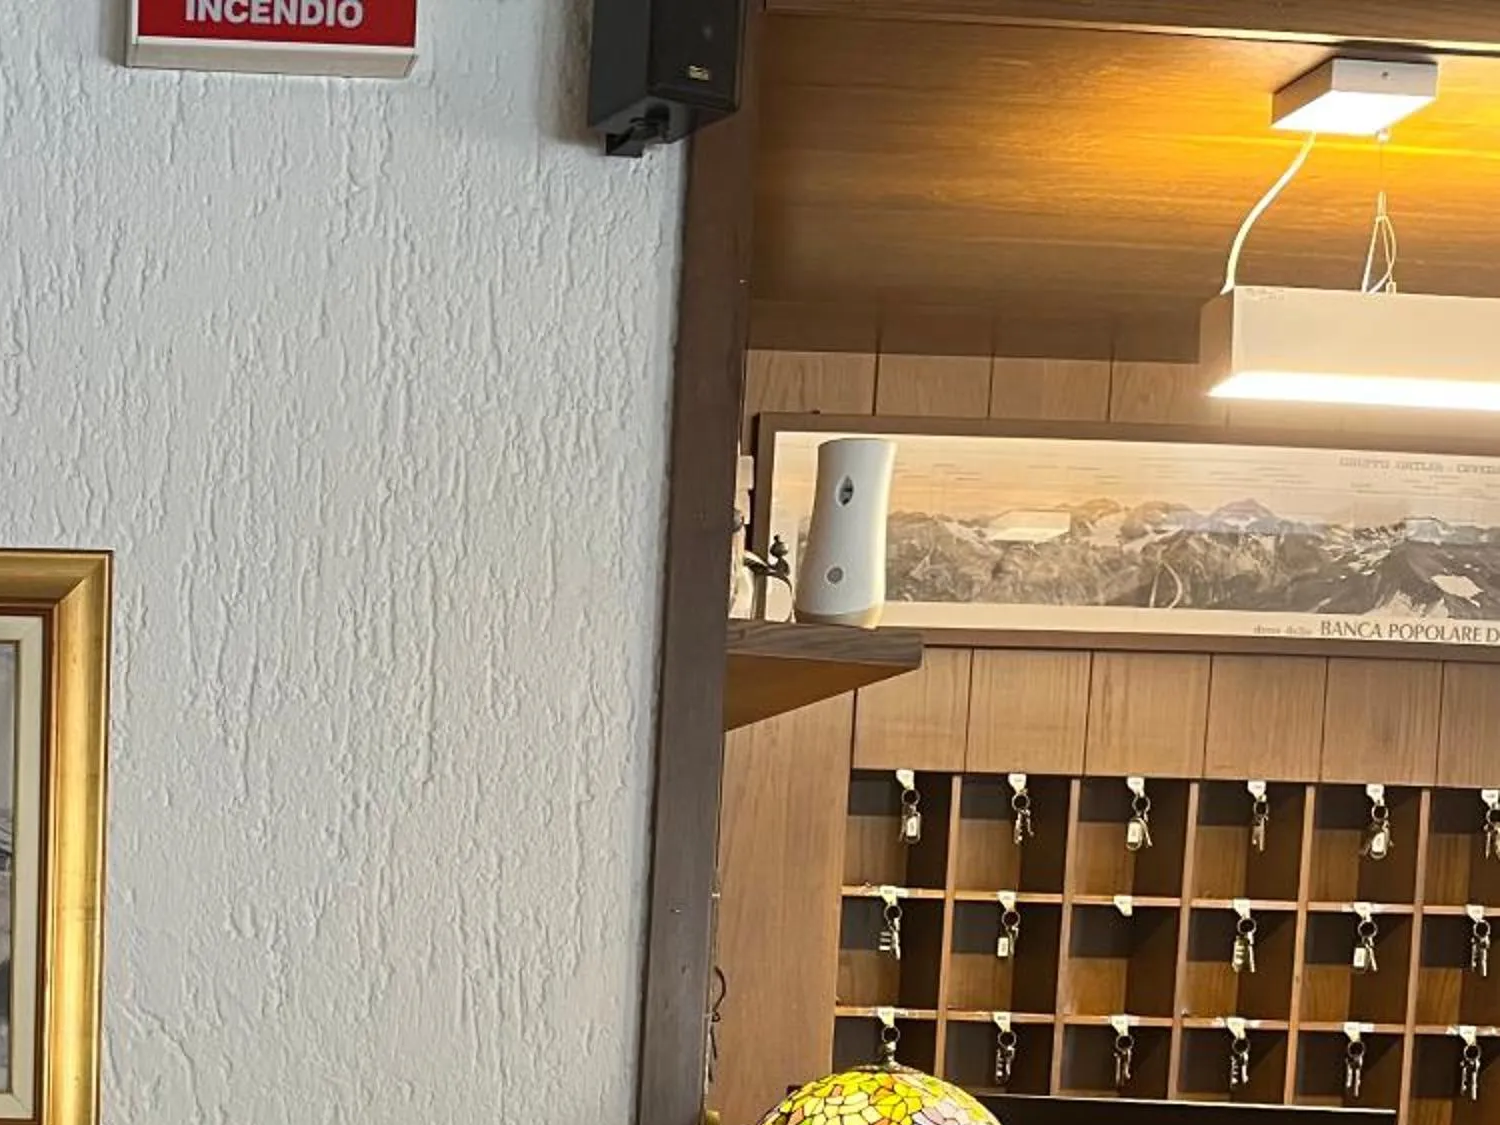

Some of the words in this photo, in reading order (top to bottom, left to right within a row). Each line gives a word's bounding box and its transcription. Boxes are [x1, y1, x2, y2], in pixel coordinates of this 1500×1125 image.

[185, 0, 363, 28] INCENDIO
[1320, 620, 1382, 638] BANCA
[1388, 623, 1482, 643] POPOLARE
